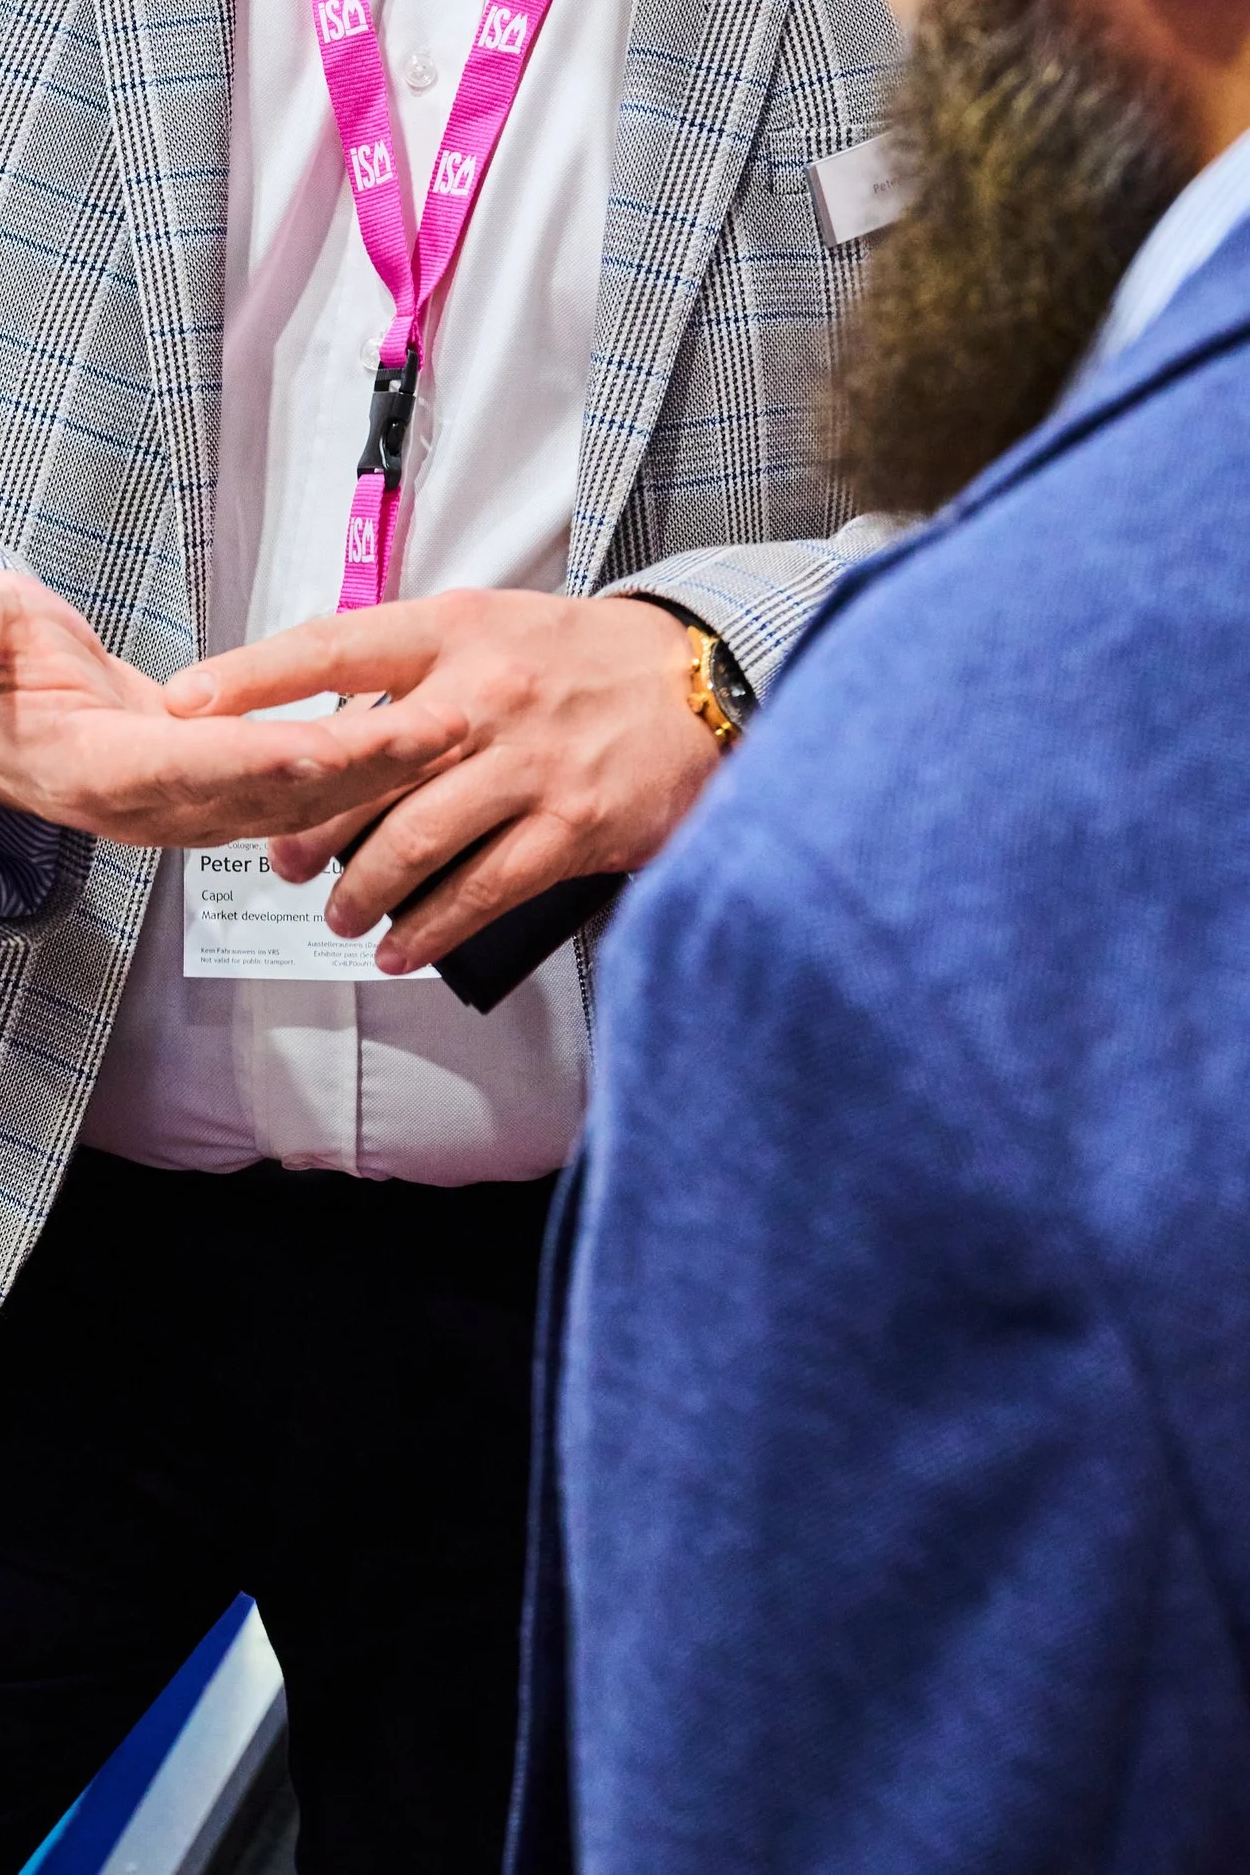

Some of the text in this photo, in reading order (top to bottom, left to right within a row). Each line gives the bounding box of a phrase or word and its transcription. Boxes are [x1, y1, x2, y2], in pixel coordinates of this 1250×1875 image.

[200, 855, 252, 873] Peter
[201, 889, 234, 903] Capol
[201, 910, 238, 921] Market
[241, 911, 309, 923] development
